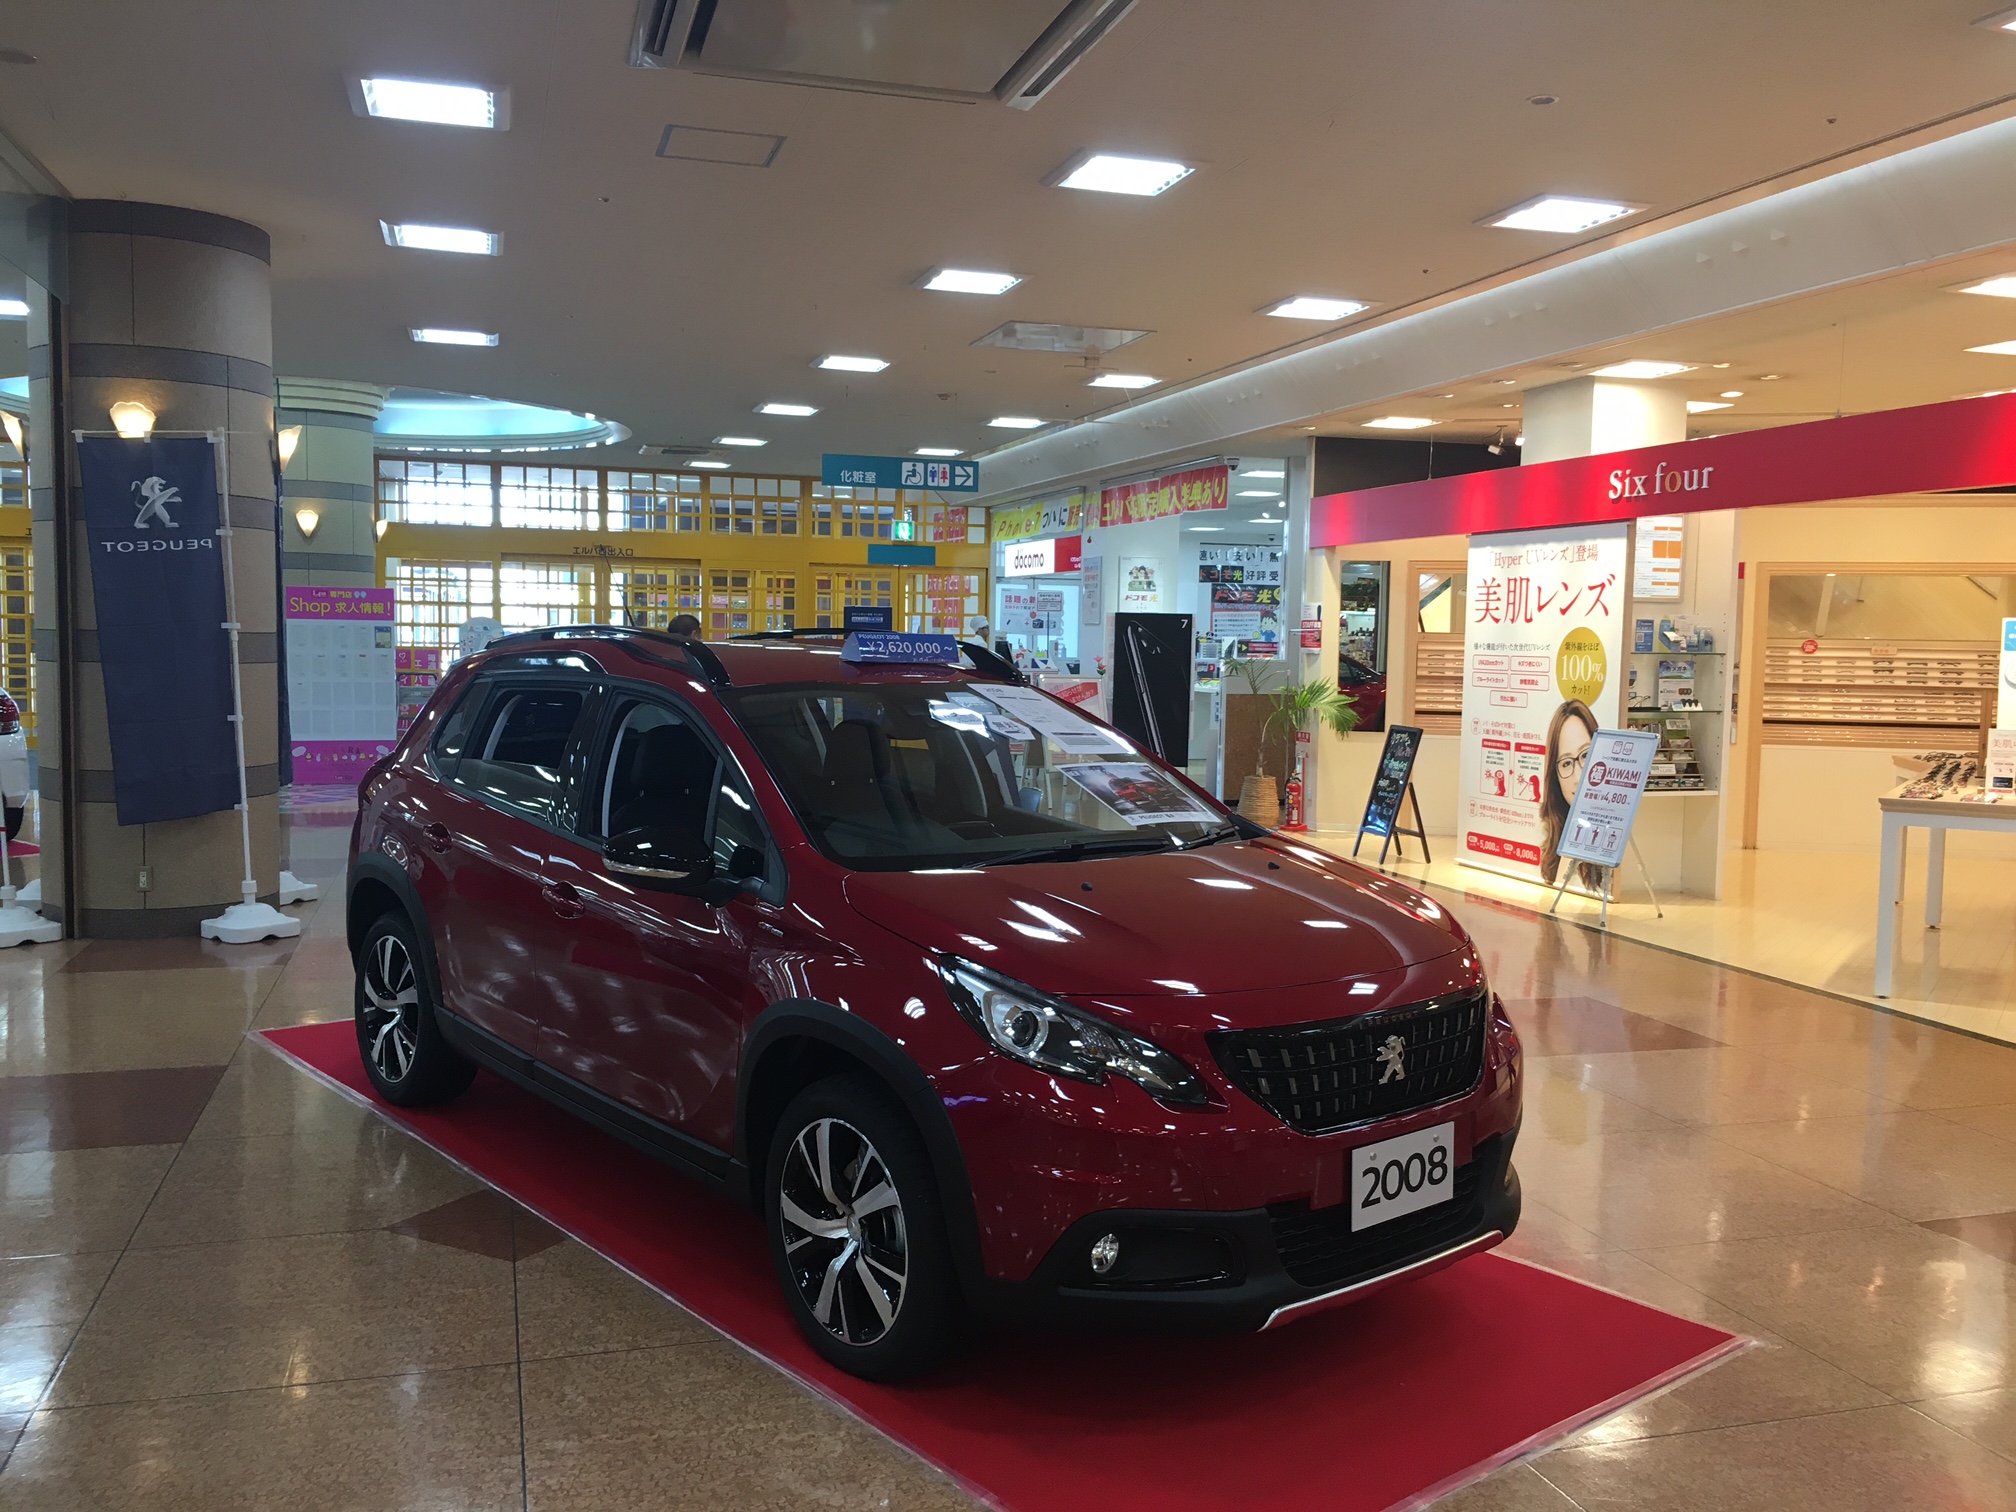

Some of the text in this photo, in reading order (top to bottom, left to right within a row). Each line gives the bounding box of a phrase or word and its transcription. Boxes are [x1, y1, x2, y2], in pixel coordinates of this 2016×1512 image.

[840, 469, 877, 484] 化粧室
[1608, 462, 1714, 499] Six four
[1014, 549, 1045, 569] docomo
[290, 597, 391, 617] Shop 求人情報!
[1474, 573, 1616, 625] 美肌レンズ
[1180, 619, 1189, 629] 7
[1565, 641, 1600, 652] 紫外線をほぼ
[1561, 654, 1604, 683] 100%
[1606, 767, 1642, 783] KIWAMI
[1361, 1145, 1448, 1210] 2008
